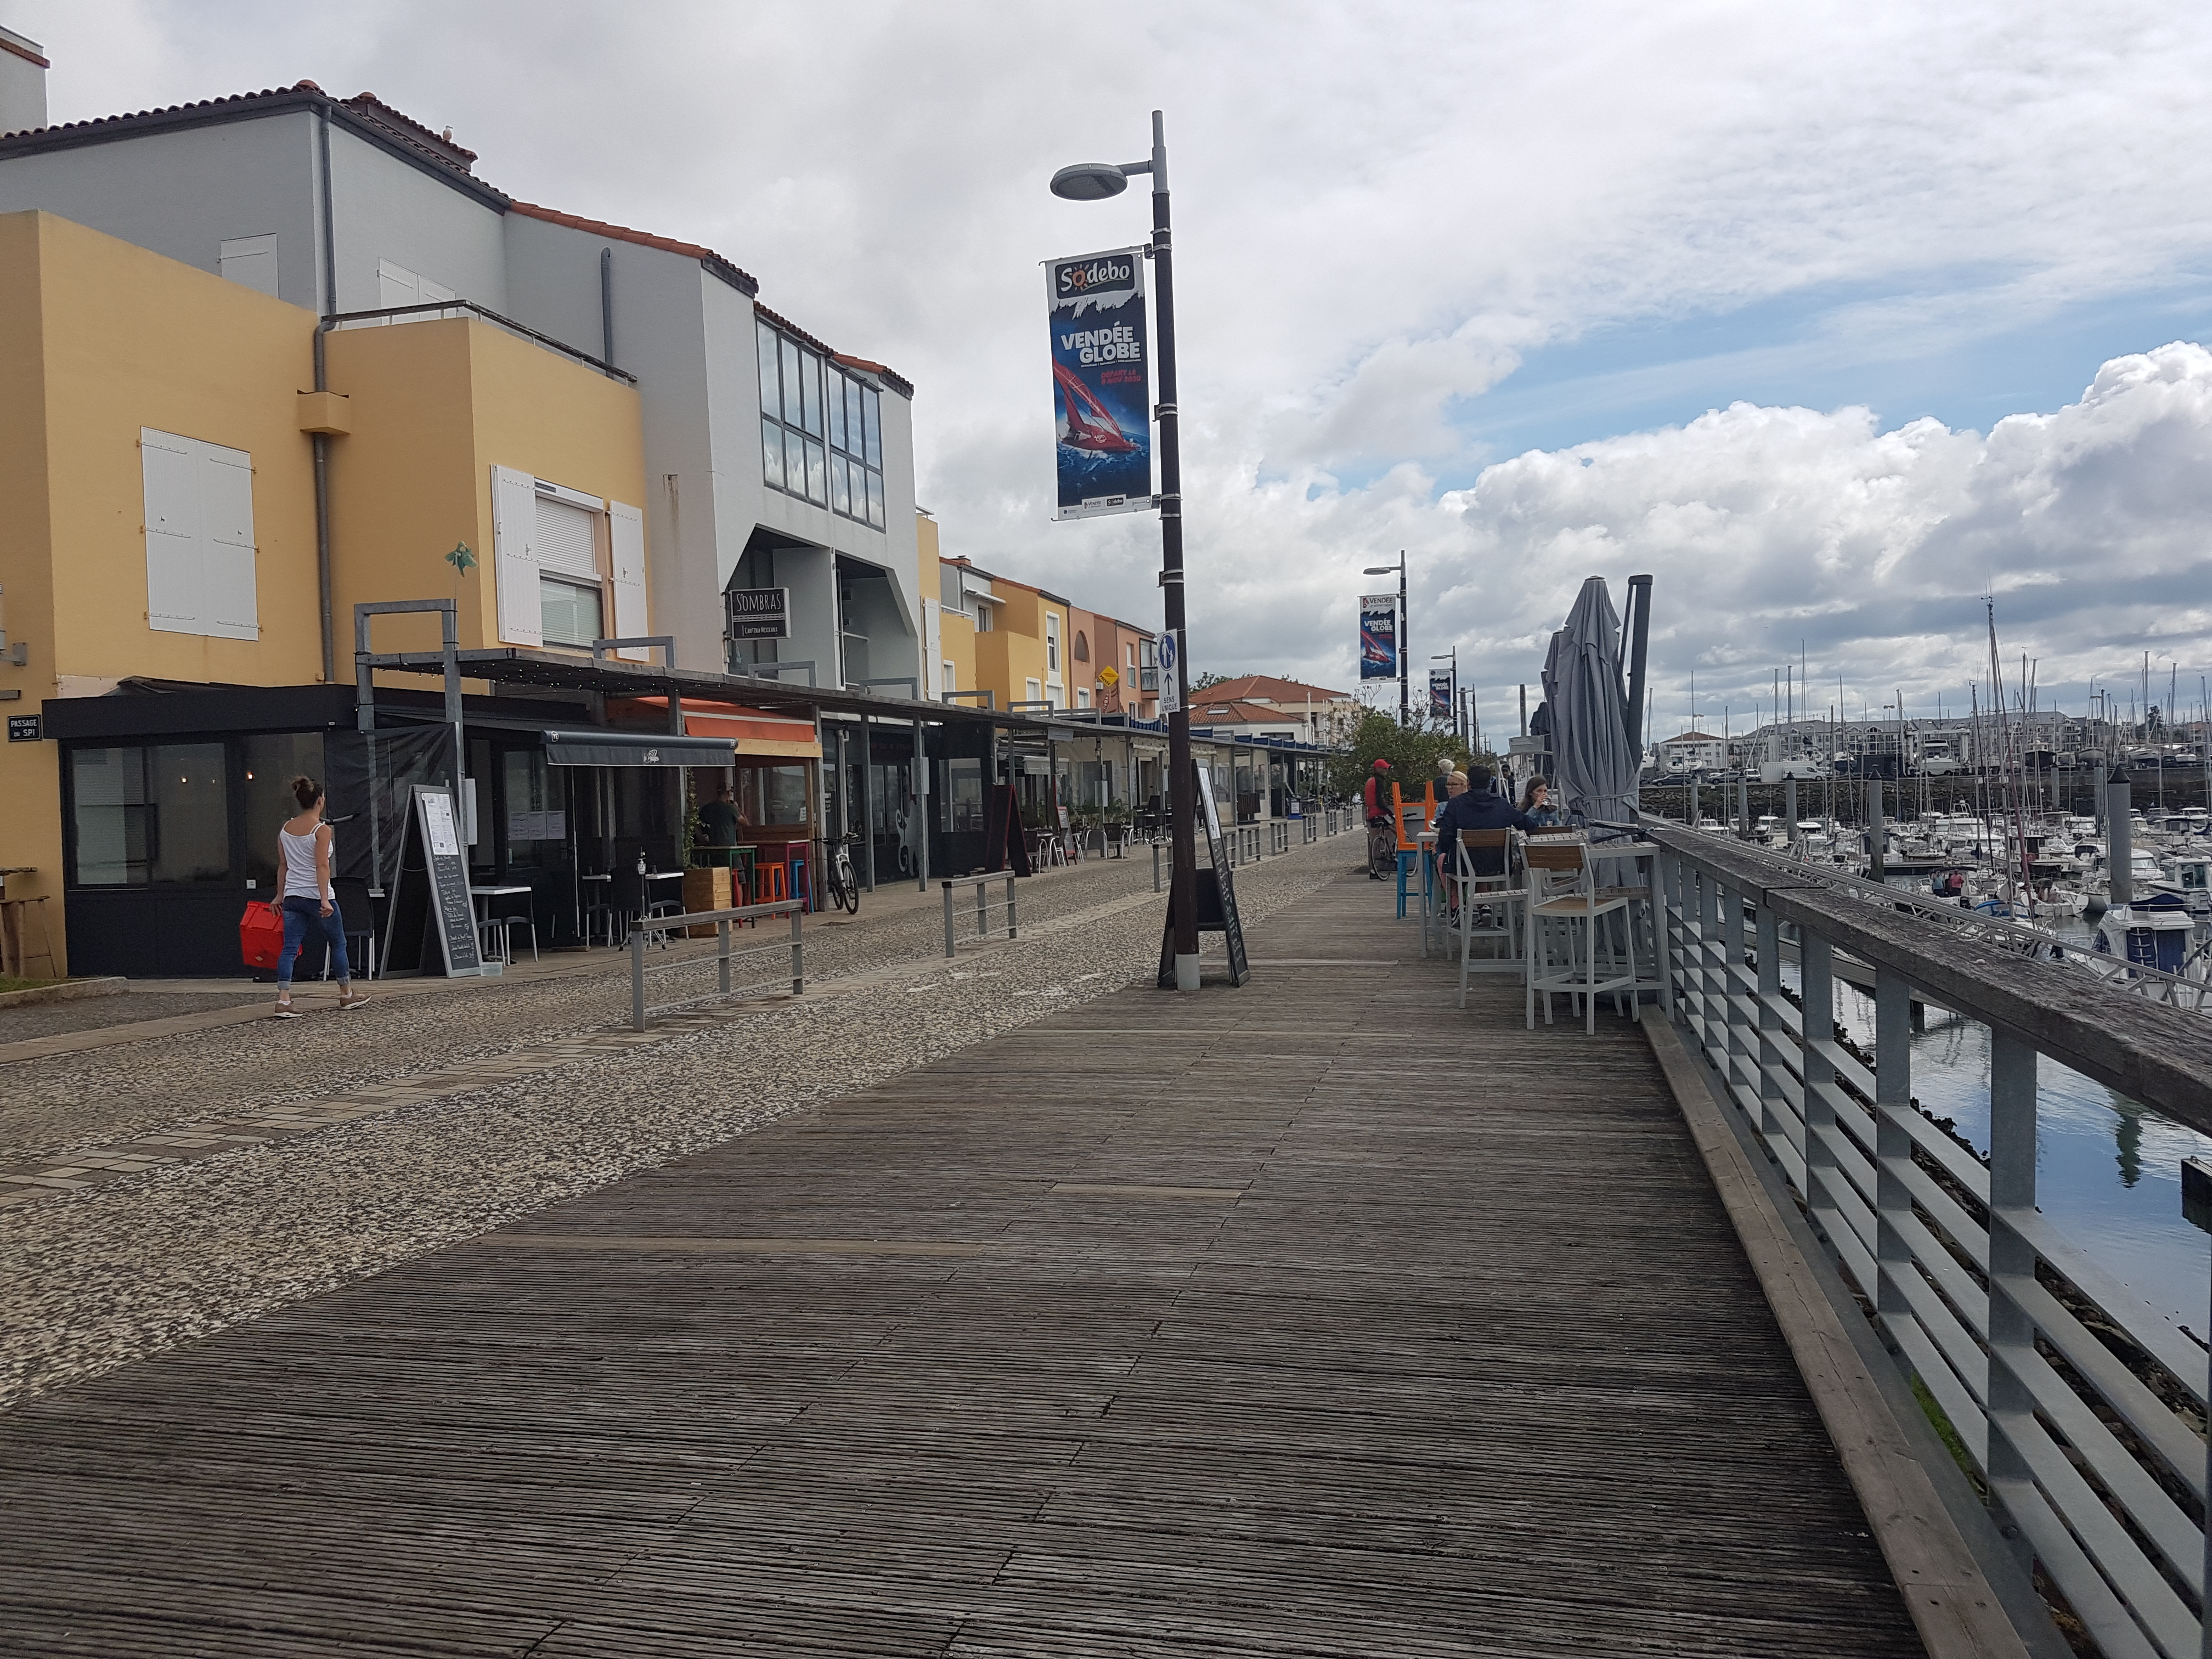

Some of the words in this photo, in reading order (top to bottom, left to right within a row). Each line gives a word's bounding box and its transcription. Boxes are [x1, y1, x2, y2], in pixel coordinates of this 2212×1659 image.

[1060, 260, 1130, 292] Sodebo
[1060, 320, 1133, 351] VENDÉE
[1079, 342, 1141, 364] GLOBE
[736, 593, 781, 612] SOMBRAS
[1364, 618, 1391, 627] VENDÉE
[1164, 696, 1175, 704] SENS
[1161, 703, 1177, 712] UNIQUE
[10, 719, 37, 727] PASSAGE
